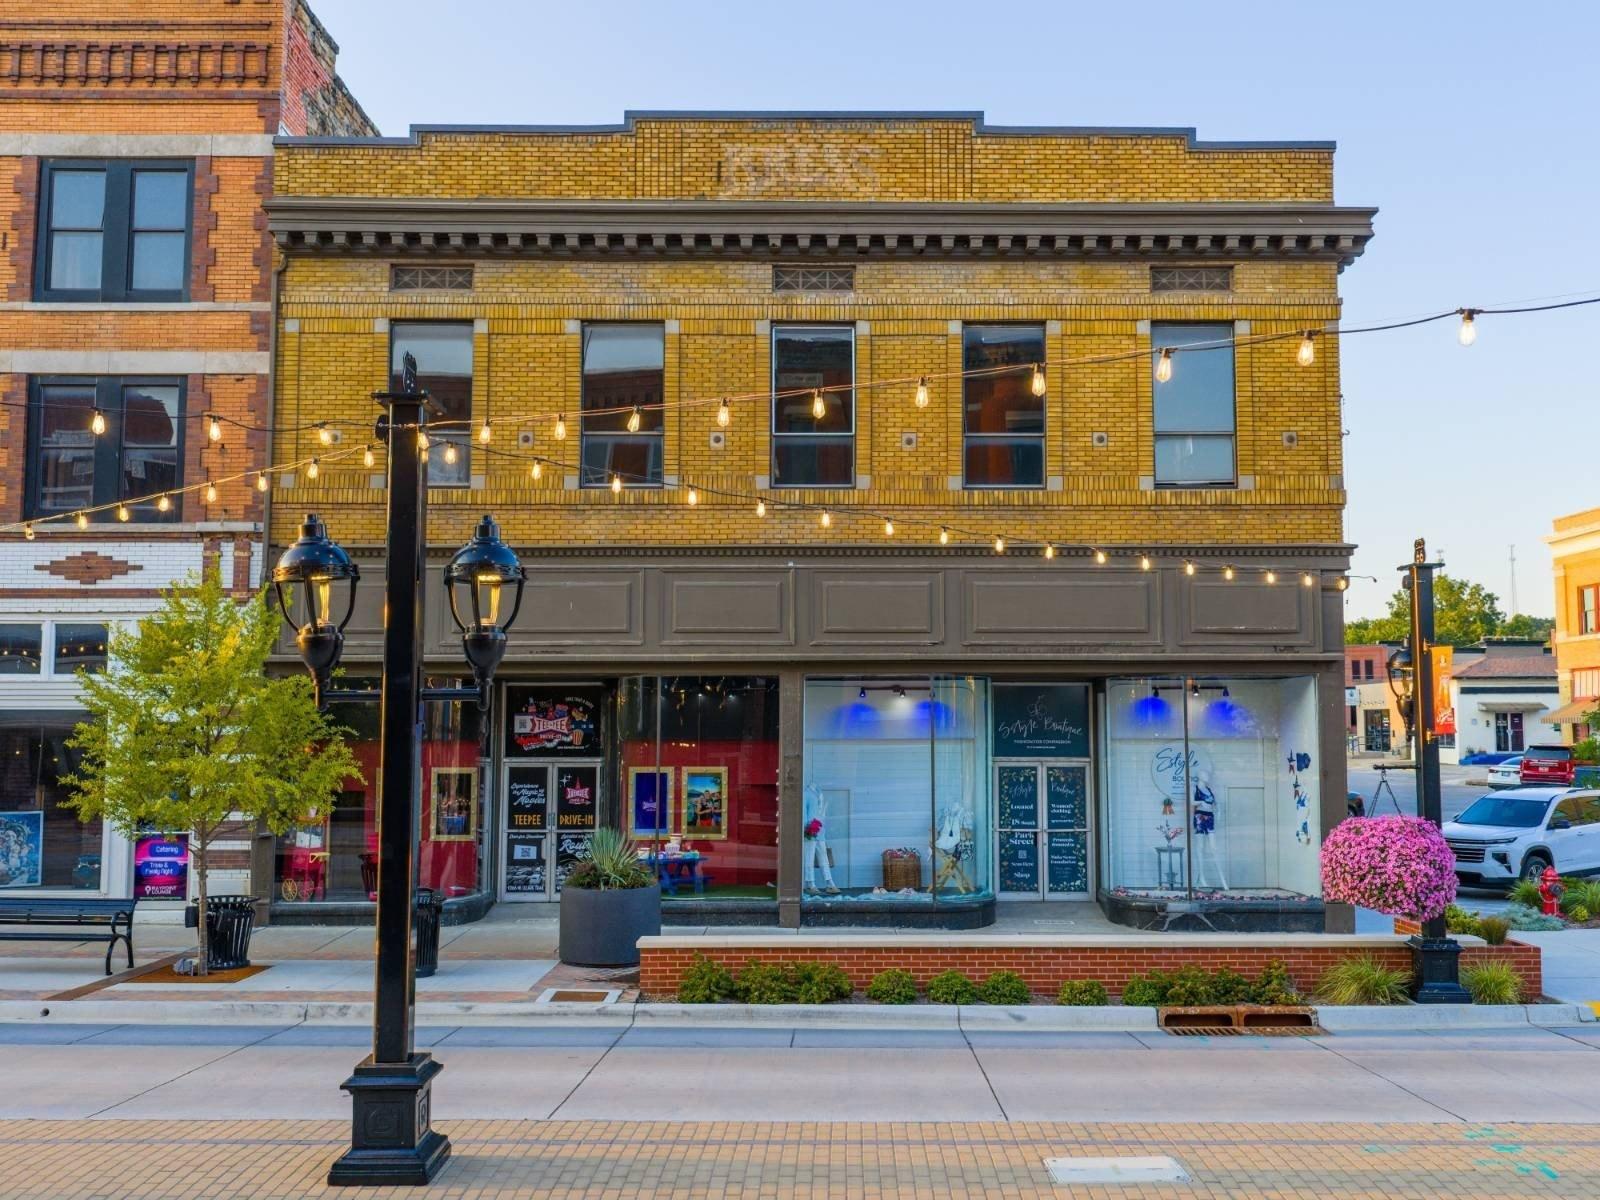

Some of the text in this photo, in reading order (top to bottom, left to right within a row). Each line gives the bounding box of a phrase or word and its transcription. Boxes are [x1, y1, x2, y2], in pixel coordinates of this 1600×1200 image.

[514, 814, 542, 825] TEEPEE
[560, 814, 594, 825] DRIVE-IN
[155, 846, 178, 854] Catering
